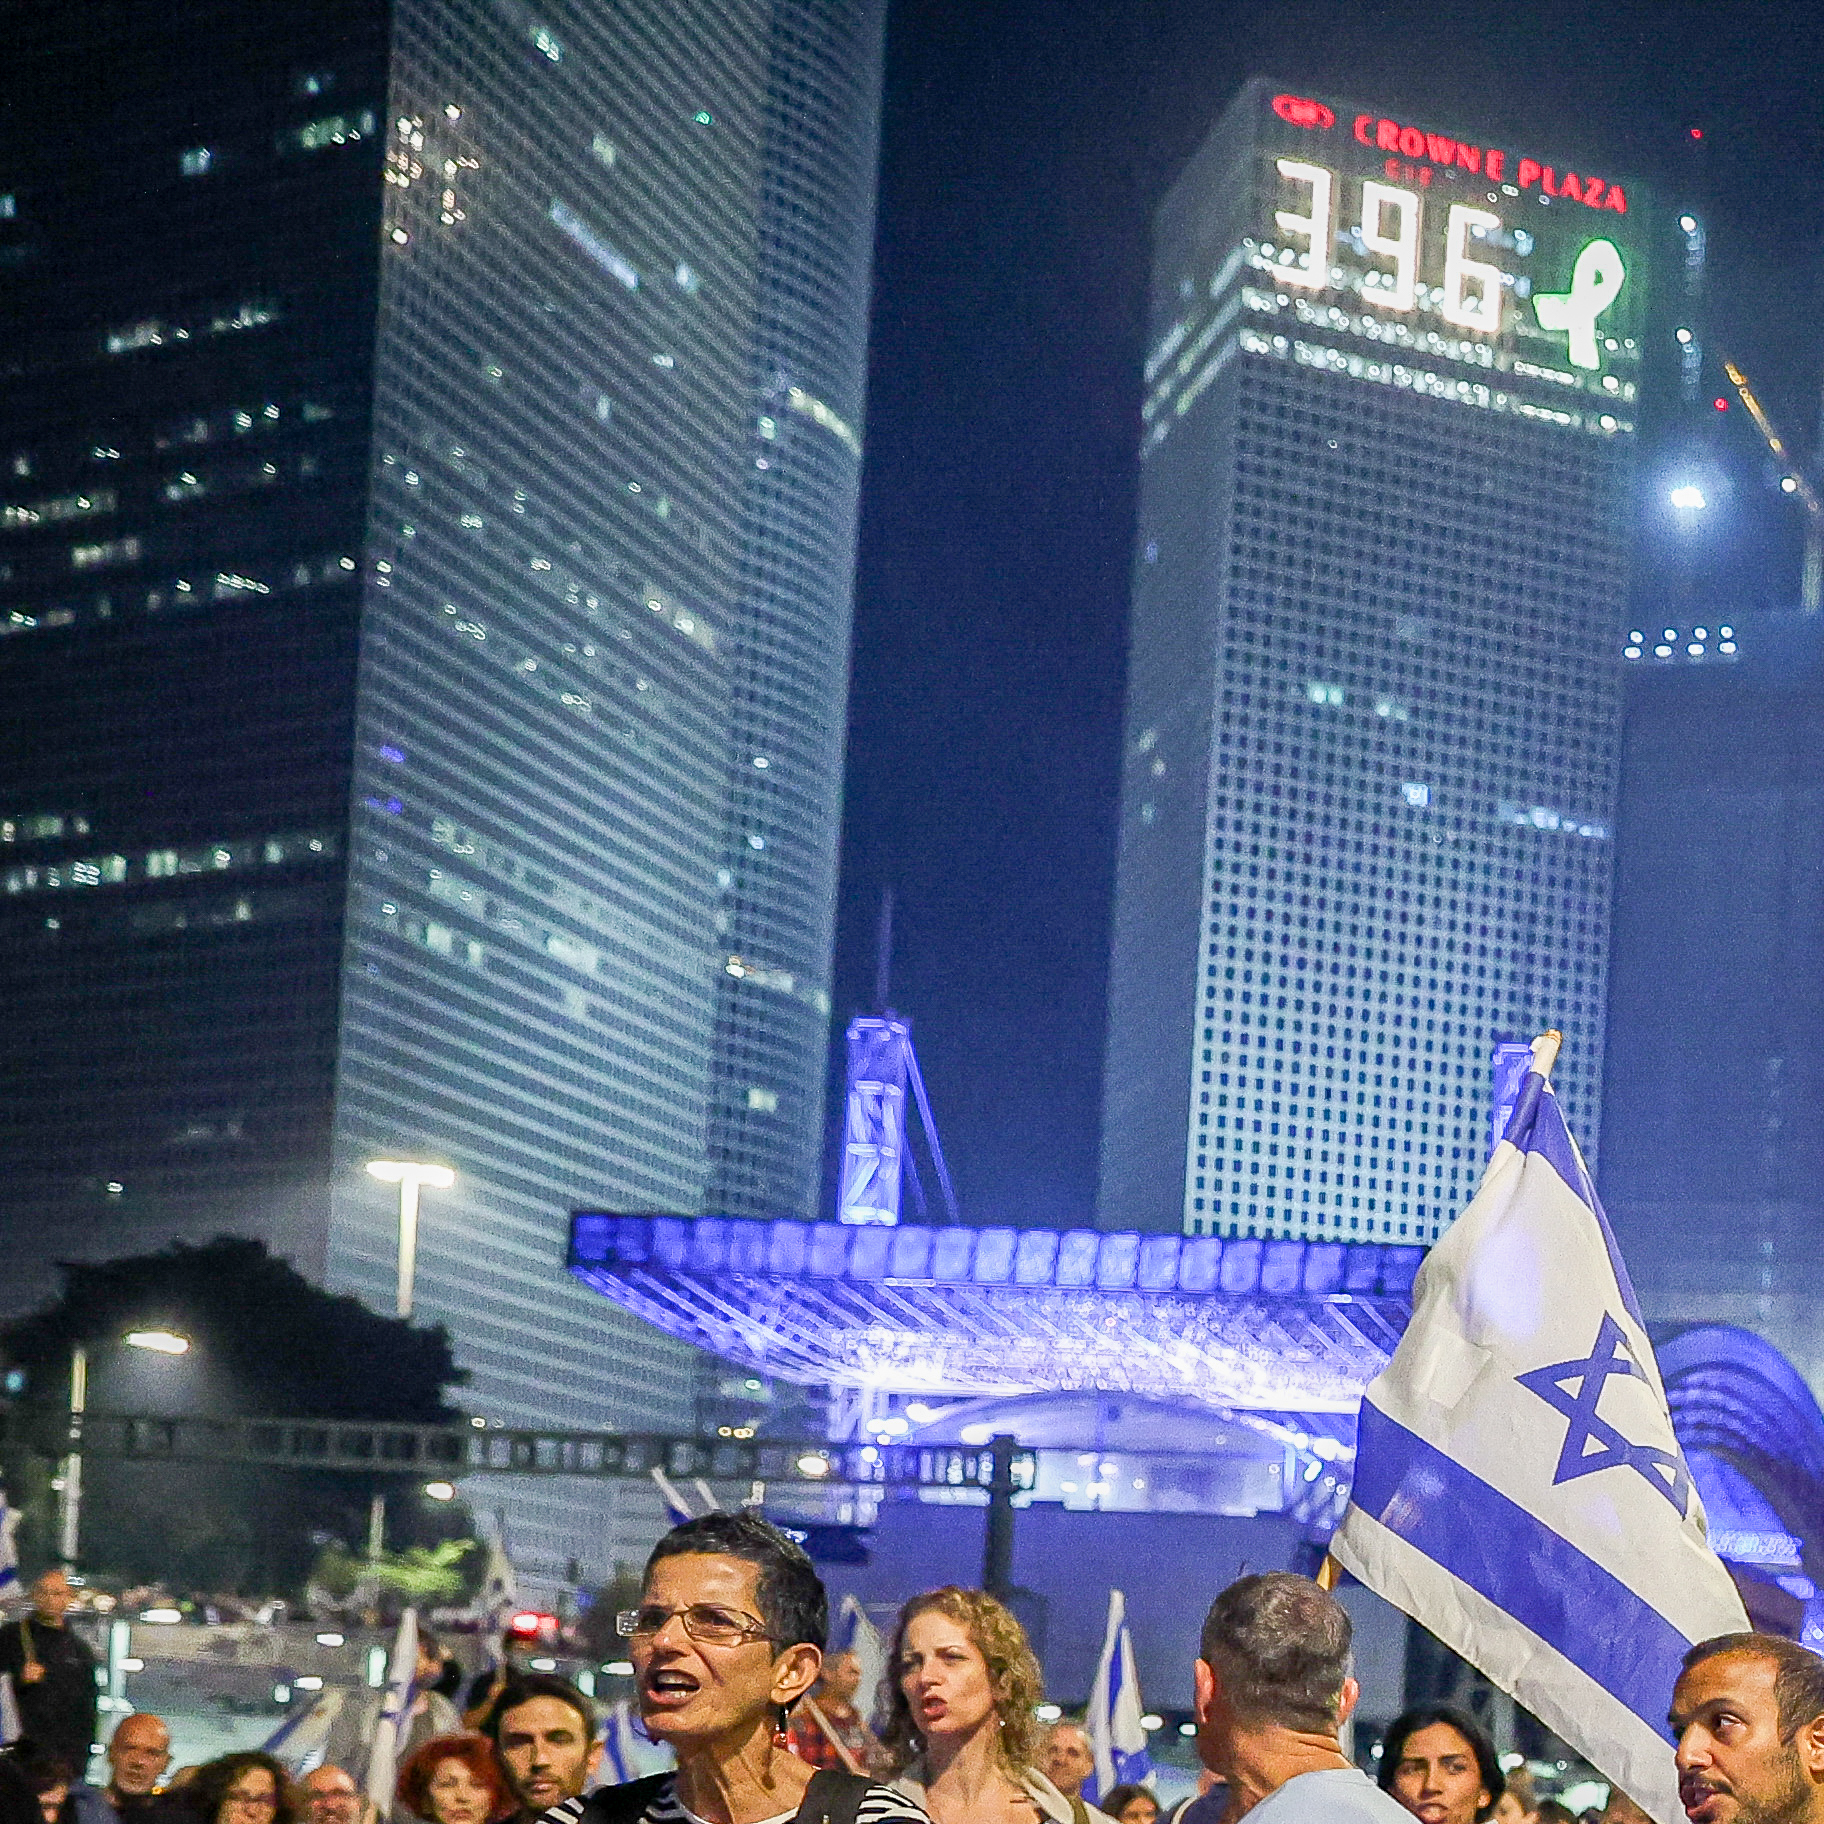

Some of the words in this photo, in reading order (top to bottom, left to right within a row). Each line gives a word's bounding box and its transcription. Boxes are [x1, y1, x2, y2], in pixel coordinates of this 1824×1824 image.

[1353, 113, 1505, 181] CROWNE
[1518, 157, 1628, 214] PLAZA
[1271, 157, 1503, 333] 396
